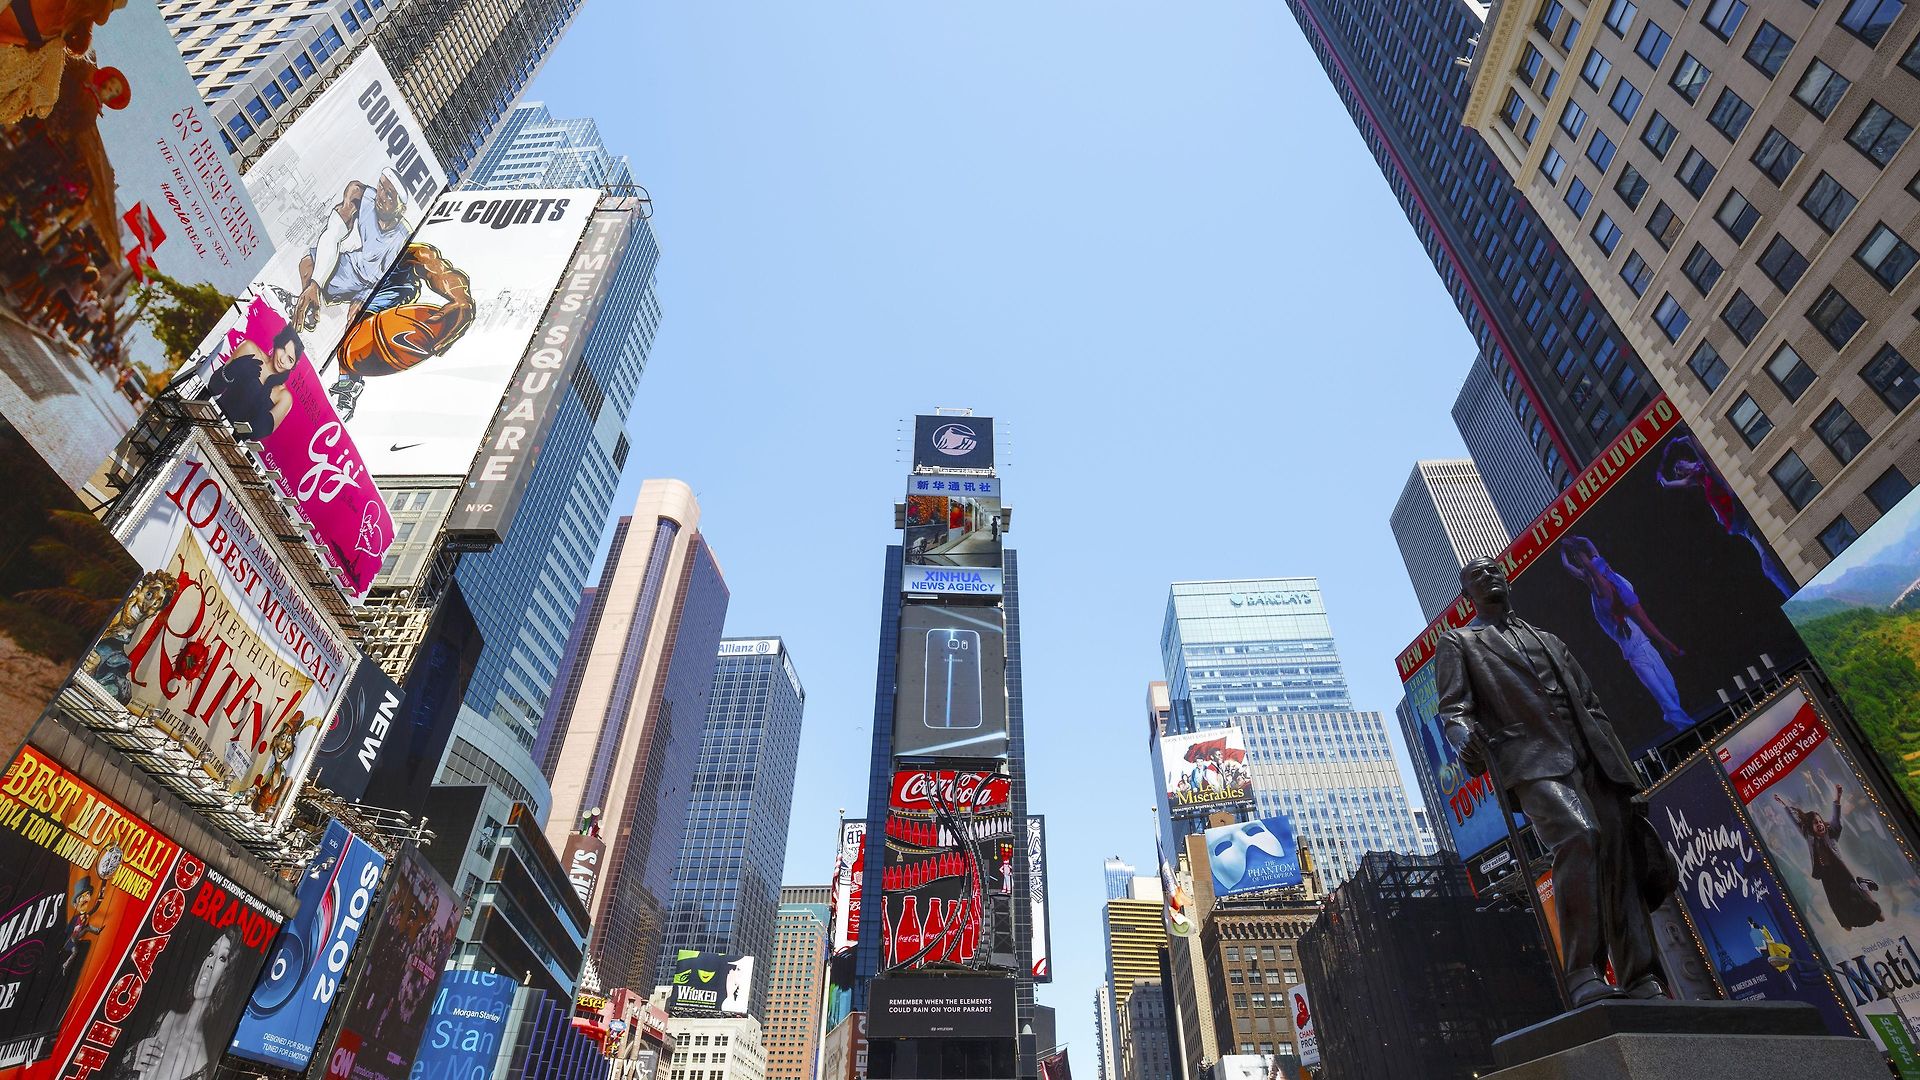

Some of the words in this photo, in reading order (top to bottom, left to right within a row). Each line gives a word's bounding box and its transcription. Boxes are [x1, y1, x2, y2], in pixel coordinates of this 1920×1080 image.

[181, 104, 203, 134] NO
[200, 138, 260, 249] RETOUCHING
[358, 80, 438, 210] CONQUER
[155, 137, 174, 164] THE
[172, 167, 192, 195] REAL
[190, 199, 206, 223] YOU
[204, 226, 215, 240] IS
[213, 239, 232, 269] SEXY
[171, 113, 190, 142] ON
[189, 143, 223, 203] THESE
[220, 207, 252, 261] GIRLS!
[434, 200, 462, 218] ALL
[460, 199, 570, 230] COURTS
[560, 218, 622, 313] TIMES
[480, 325, 568, 481] SQUARE
[465, 503, 493, 512] NYC
[916, 480, 991, 493] 新华通讯社
[1532, 508, 1564, 546] IT'S
[1564, 495, 1578, 516] A
[1576, 429, 1648, 502] HELLUVA
[165, 459, 223, 530] 10
[225, 502, 254, 542] TONY
[252, 541, 287, 591] AWARD
[287, 586, 344, 668] NOMINATIONS!
[911, 582, 945, 591] NEWS
[947, 582, 995, 592] AGENCY
[925, 571, 982, 583] XINHUA
[195, 568, 292, 690] SOMETHING
[207, 524, 262, 598] BEST
[256, 585, 337, 693] MUSICAL!
[719, 643, 754, 653] Allianz
[1400, 645, 1423, 675] NEW
[357, 690, 400, 773] NEW
[1740, 758, 1763, 780] TIME
[1760, 722, 1806, 764] Magazine's
[1743, 784, 1755, 798] #1
[1752, 768, 1775, 789] Show
[1774, 759, 1785, 772] of
[1783, 748, 1799, 765] the
[1796, 728, 1821, 752] Year!
[2, 752, 83, 822] BEST
[68, 794, 172, 880] MUSICAL!
[21, 811, 61, 849] TONY
[53, 832, 99, 871] AWARD
[112, 864, 153, 899] WINNER
[1247, 862, 1296, 877] PHANTOM
[1273, 871, 1294, 879] OPERA
[1667, 824, 1753, 892] American
[1698, 860, 1749, 913] Paris
[190, 880, 280, 956] BRANDY
[207, 868, 224, 885] NOW
[221, 880, 246, 900] STARRING
[244, 892, 268, 913] GRAMMY
[327, 861, 380, 973] SOLO
[312, 973, 336, 1004] 2
[453, 1008, 479, 1019] Morgan
[478, 1010, 501, 1024] Stanley
[263, 1032, 287, 1046] DESIGNED
[287, 1039, 298, 1048] FOR
[263, 1043, 279, 1056] TUNED
[279, 1046, 288, 1057] FOR
[331, 1047, 356, 1079] CNN
